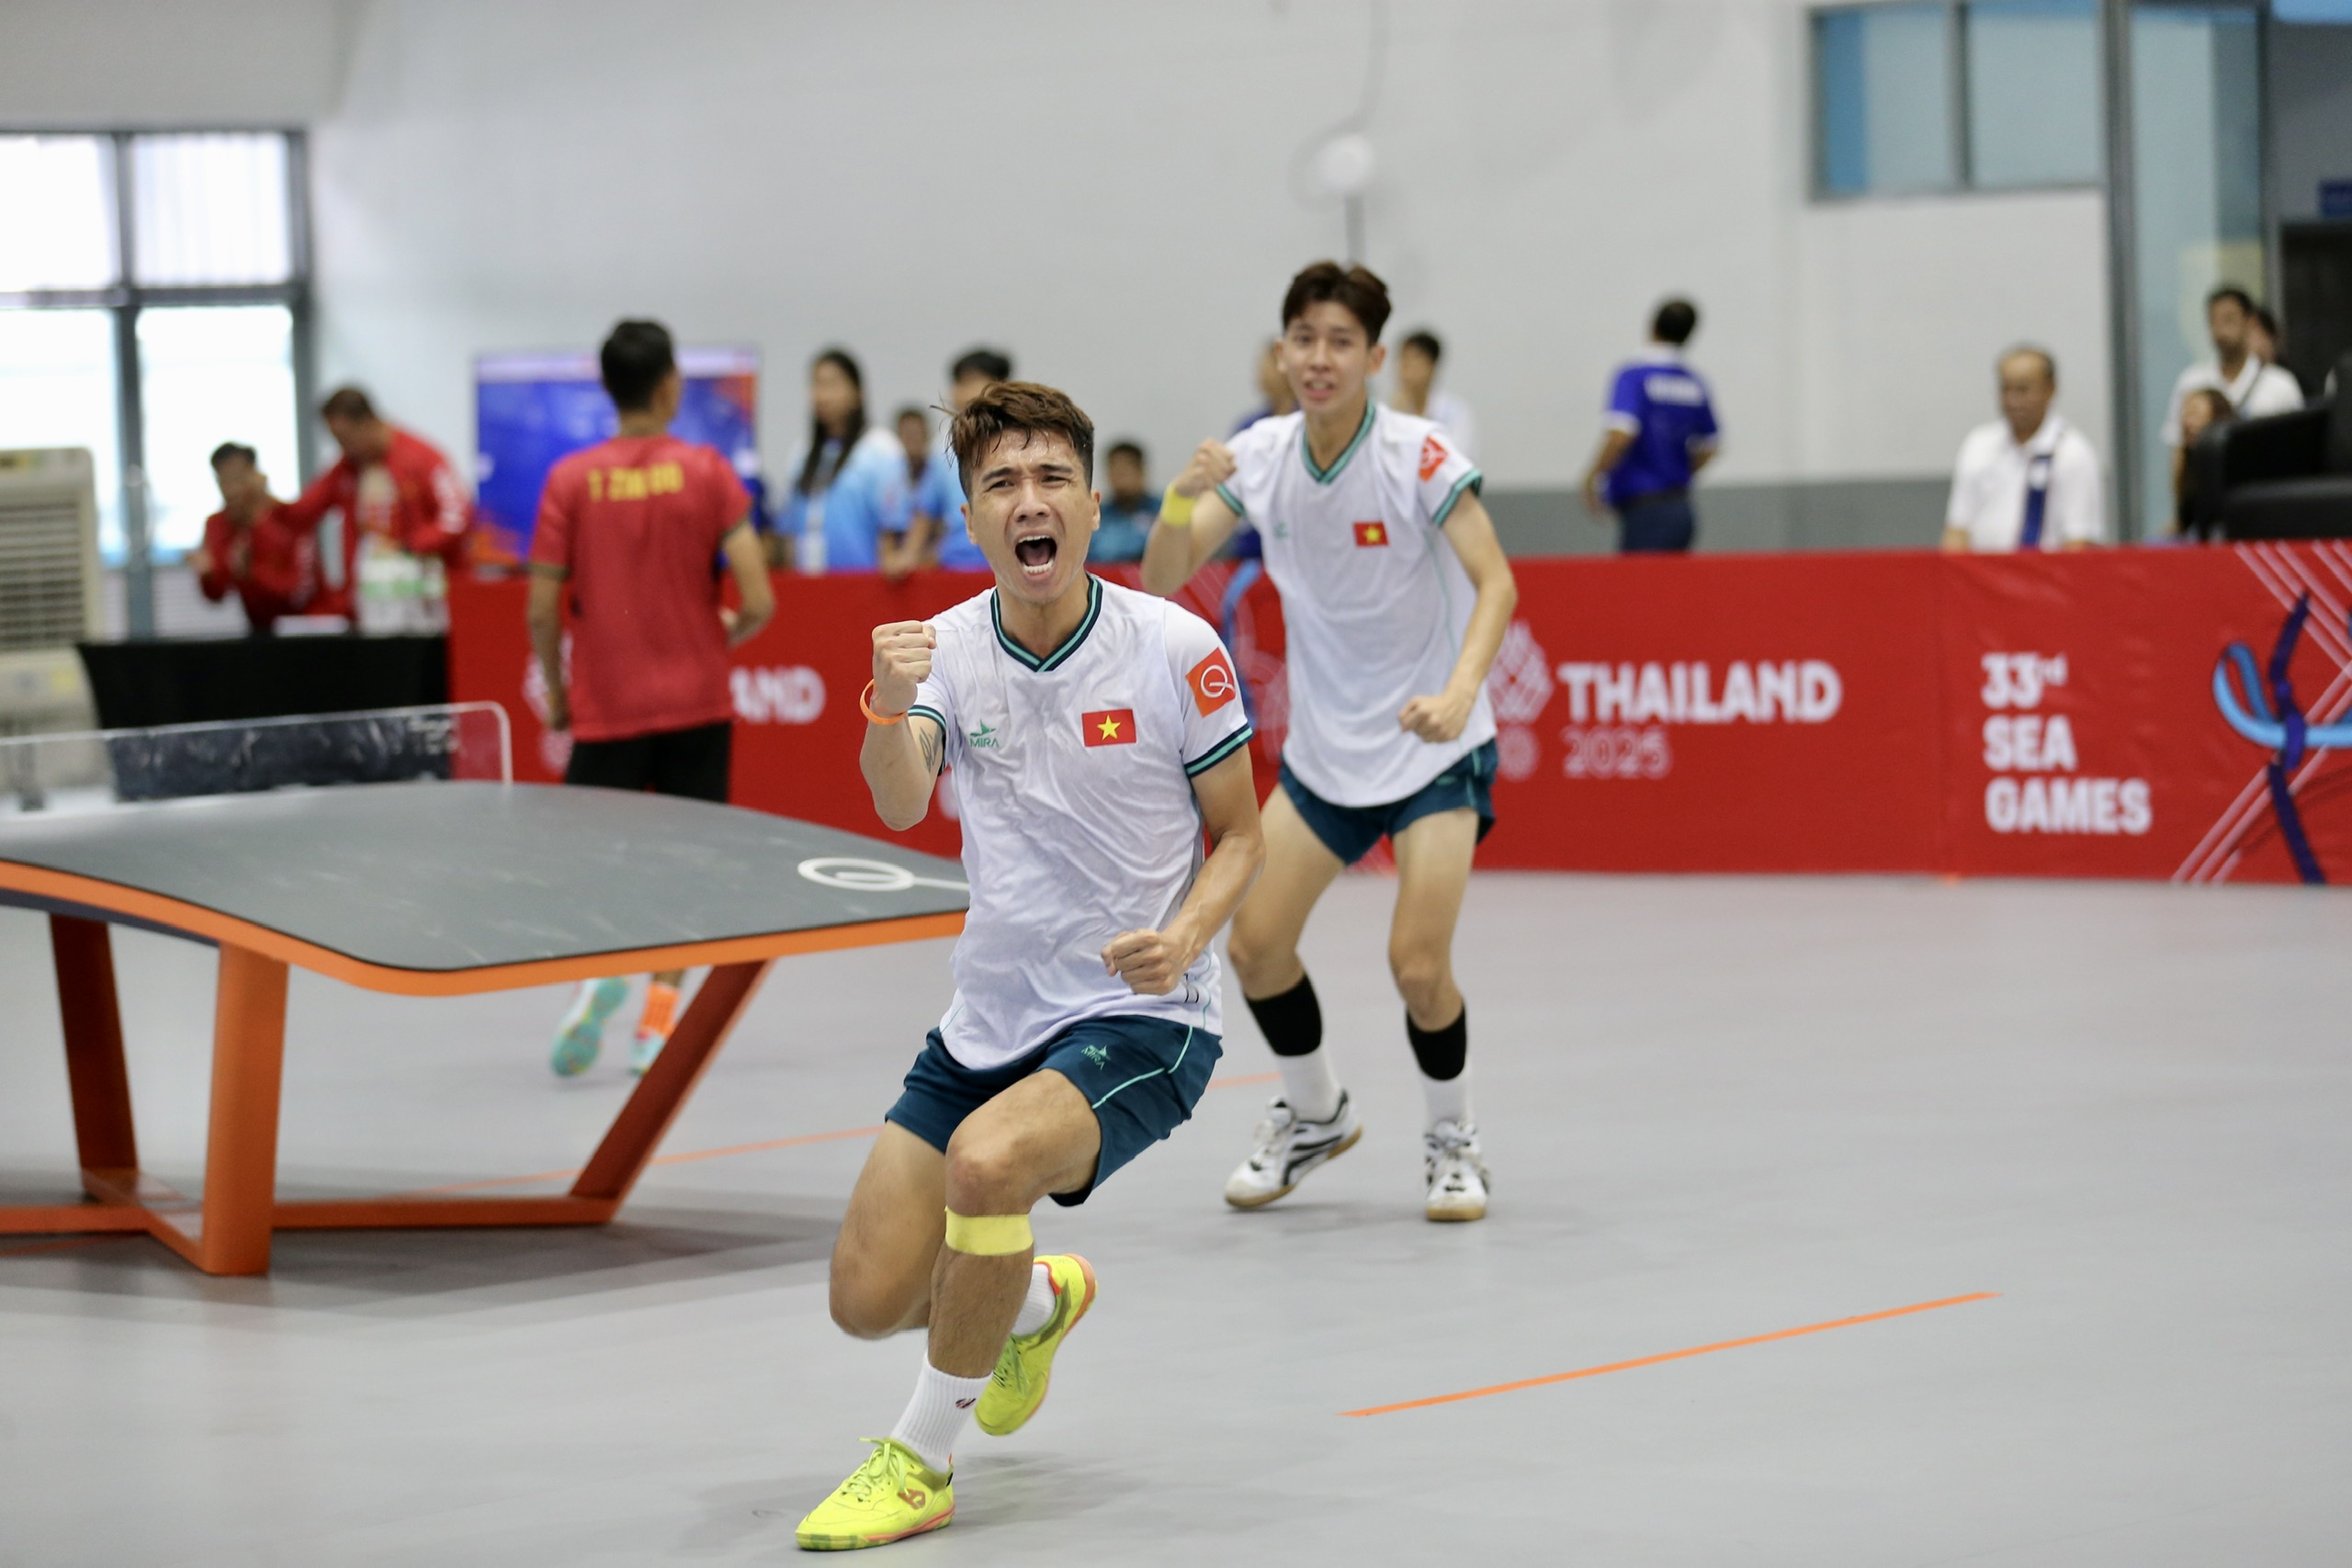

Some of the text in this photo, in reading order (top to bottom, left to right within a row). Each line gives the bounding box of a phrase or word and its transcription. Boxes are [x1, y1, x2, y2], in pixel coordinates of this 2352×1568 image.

[1559, 660, 1841, 722] THAILAND
[1981, 653, 2067, 707] 33rd
[969, 738, 1000, 748] MIRA
[1561, 726, 1671, 778] 2025
[1984, 716, 2076, 771] SEA
[1986, 779, 2152, 834] GAMES
